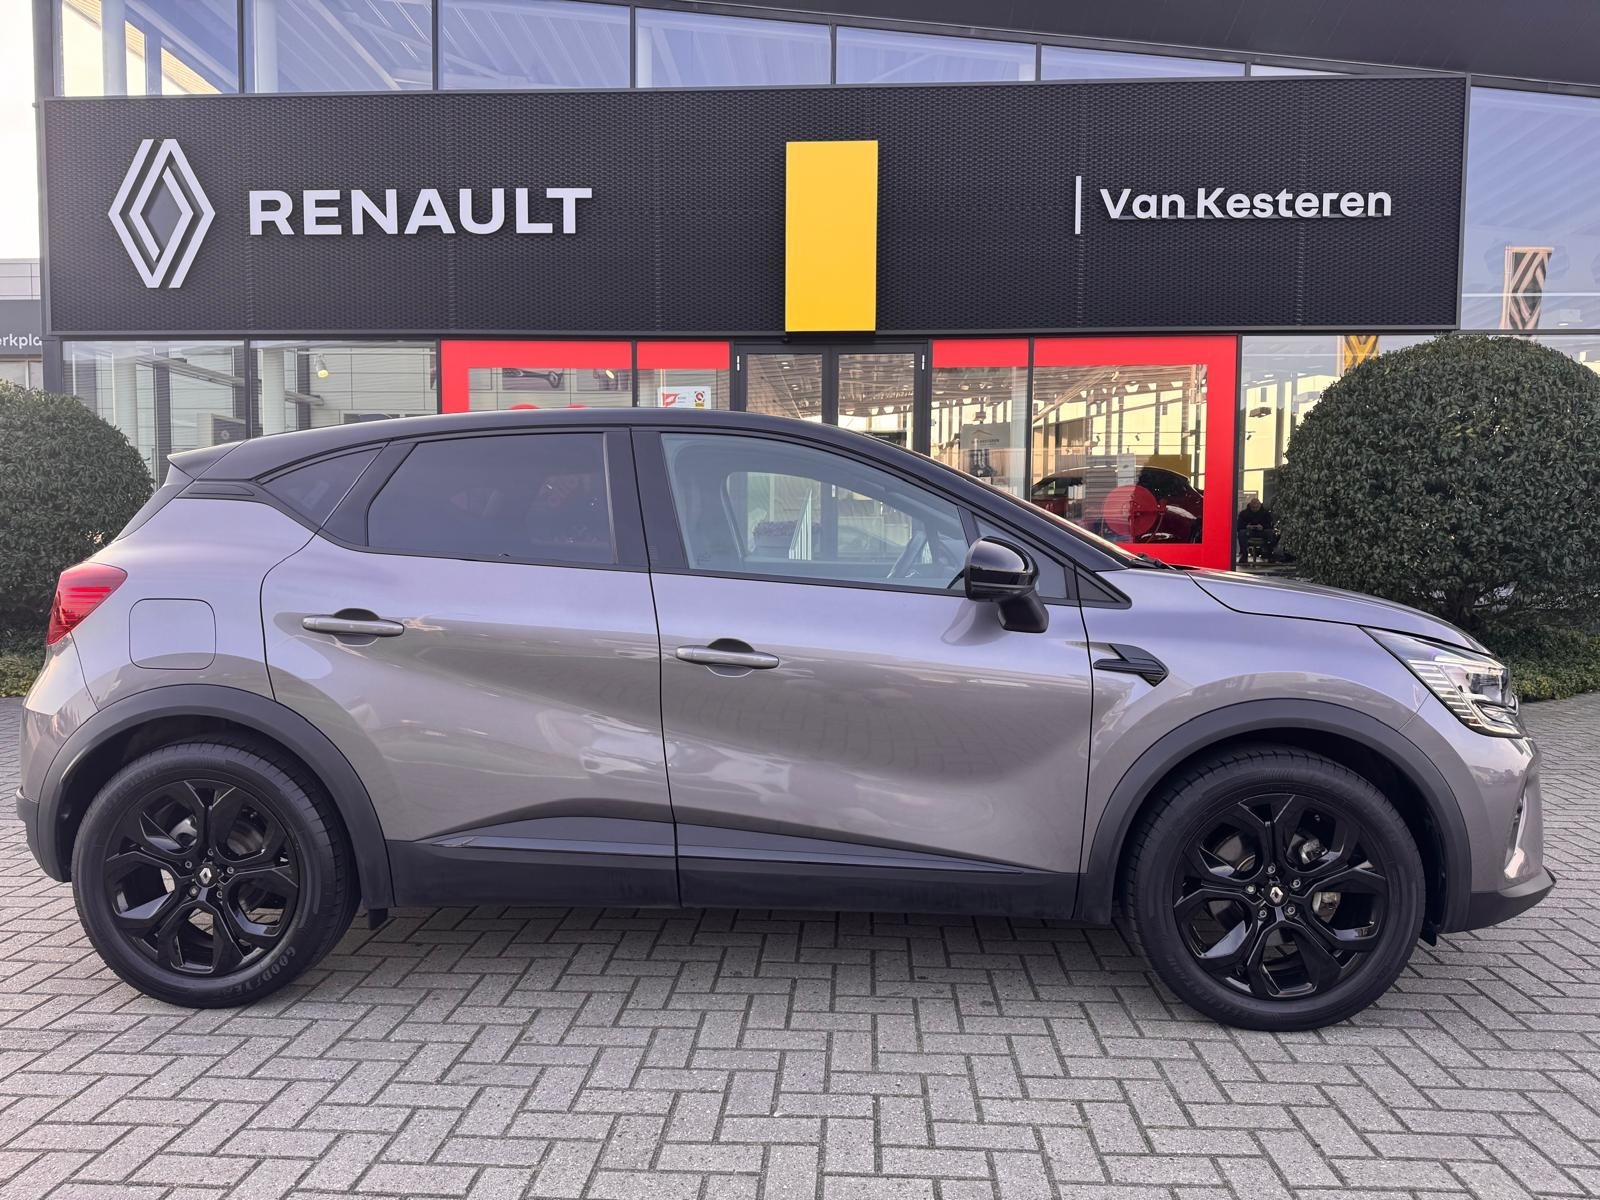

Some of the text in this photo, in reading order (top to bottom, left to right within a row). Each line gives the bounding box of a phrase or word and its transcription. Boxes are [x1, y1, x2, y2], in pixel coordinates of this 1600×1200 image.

[249, 188, 592, 235] RENAULT
[1100, 188, 1392, 219] Van Kesteren
